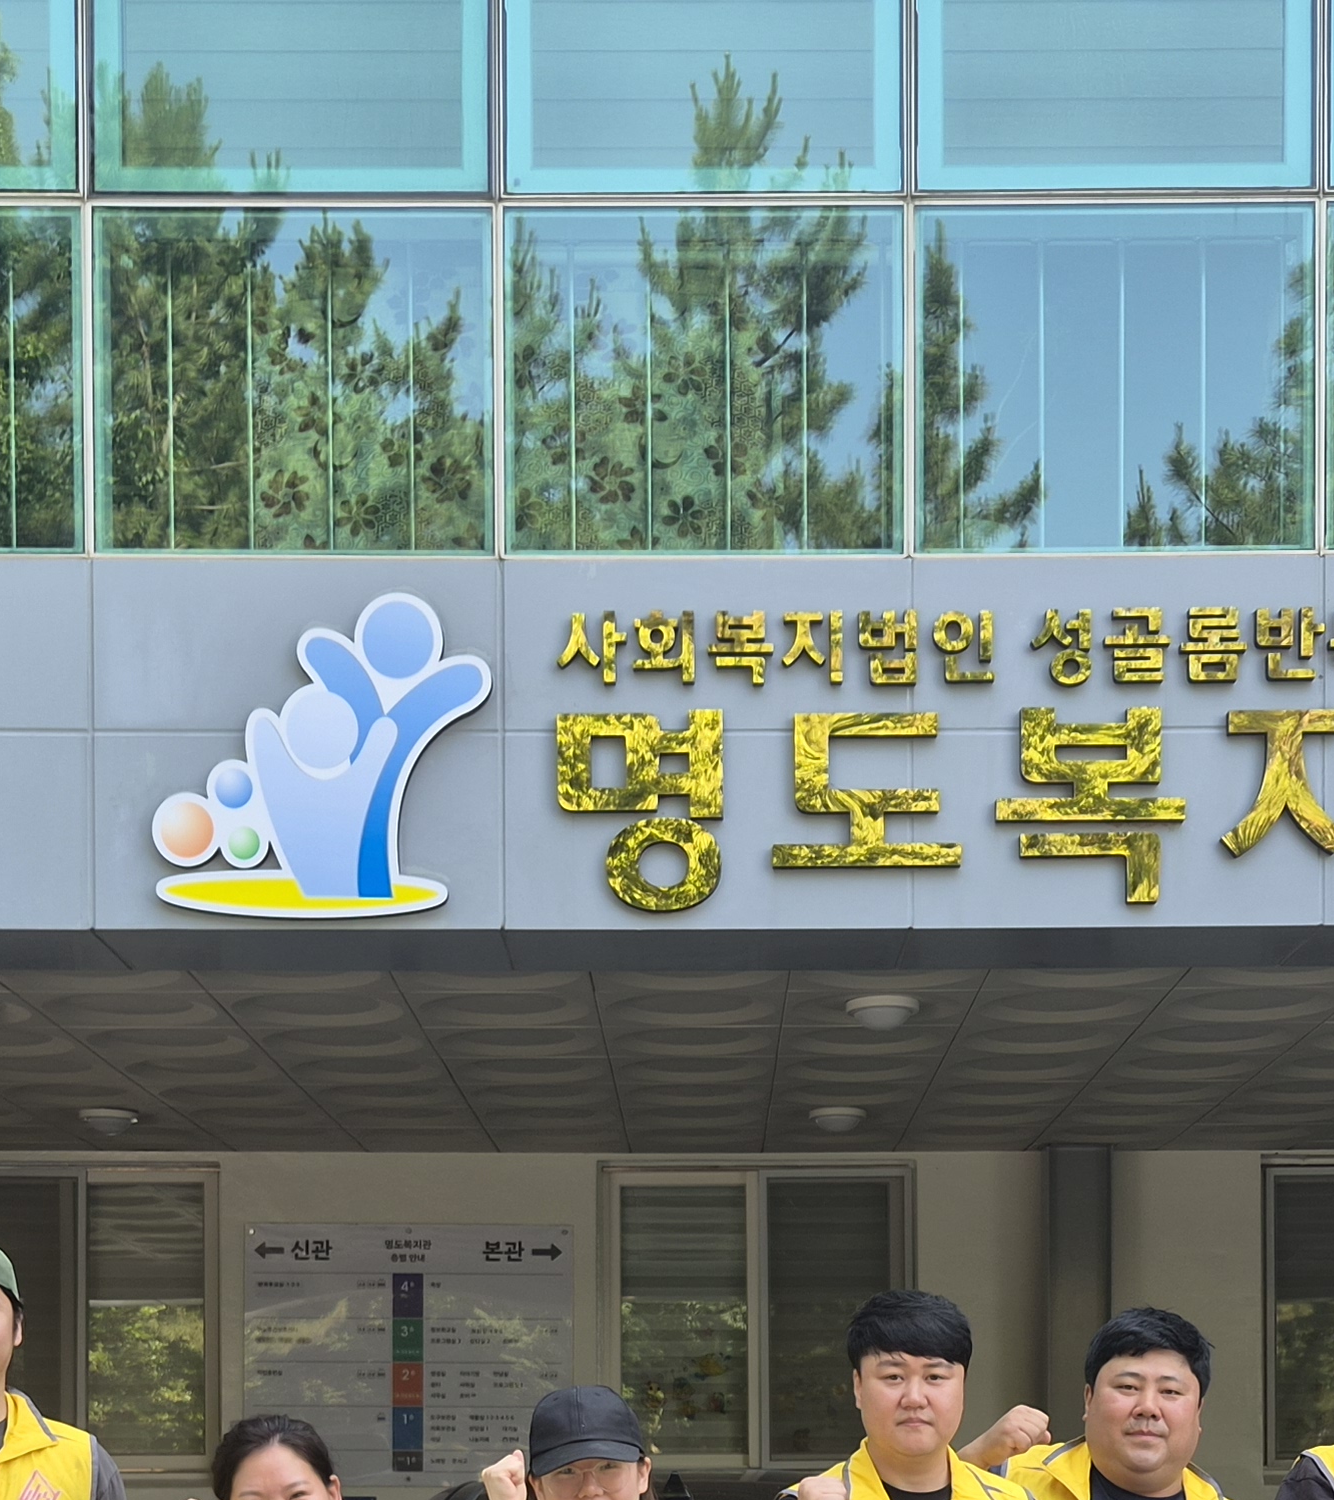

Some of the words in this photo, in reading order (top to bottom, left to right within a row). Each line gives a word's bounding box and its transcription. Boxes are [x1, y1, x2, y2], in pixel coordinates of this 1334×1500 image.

[556, 607, 995, 686] 사회복지법인
[291, 1239, 333, 1261] 신관
[384, 1239, 432, 1251] 명도복지관
[482, 1240, 525, 1262] 본관
